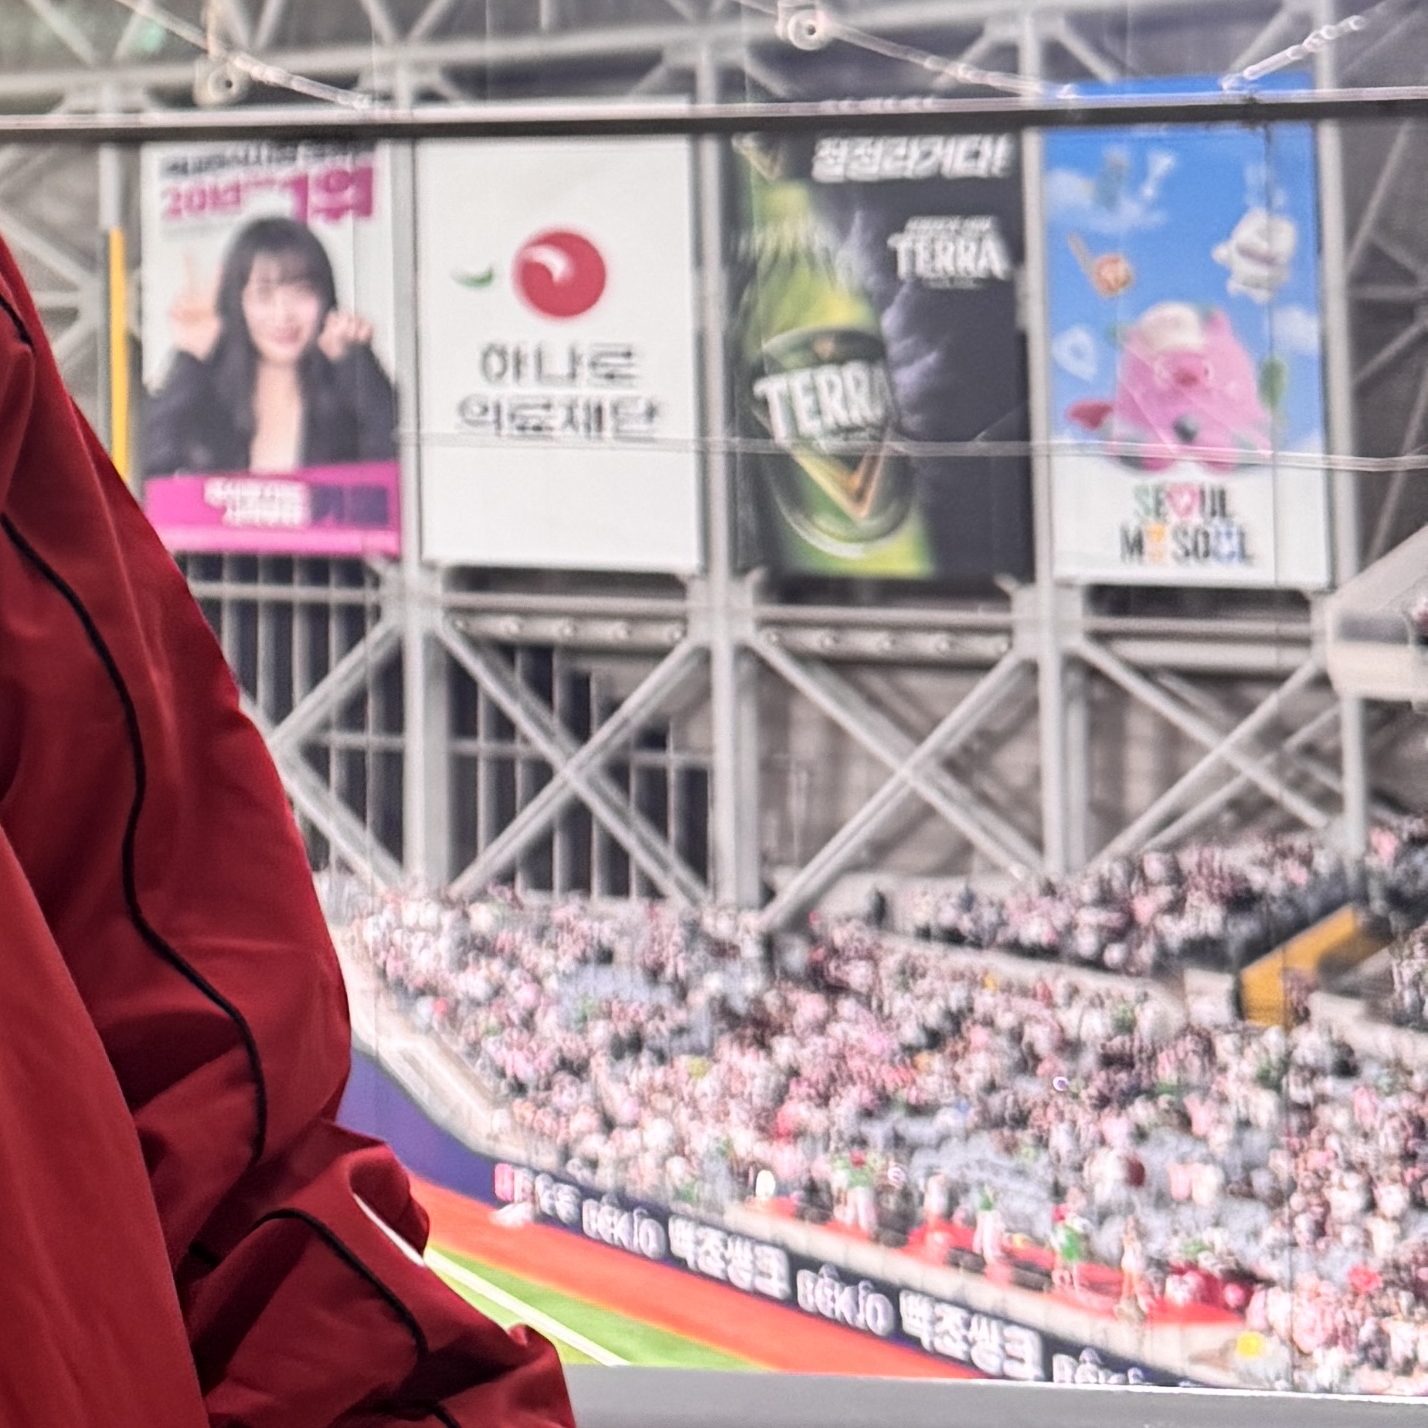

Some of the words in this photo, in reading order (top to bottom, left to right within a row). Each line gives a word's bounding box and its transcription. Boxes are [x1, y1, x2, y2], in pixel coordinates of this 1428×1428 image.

[887, 233, 1011, 281] TERRA
[479, 340, 638, 388] 하나로
[457, 395, 661, 442] 의료재단
